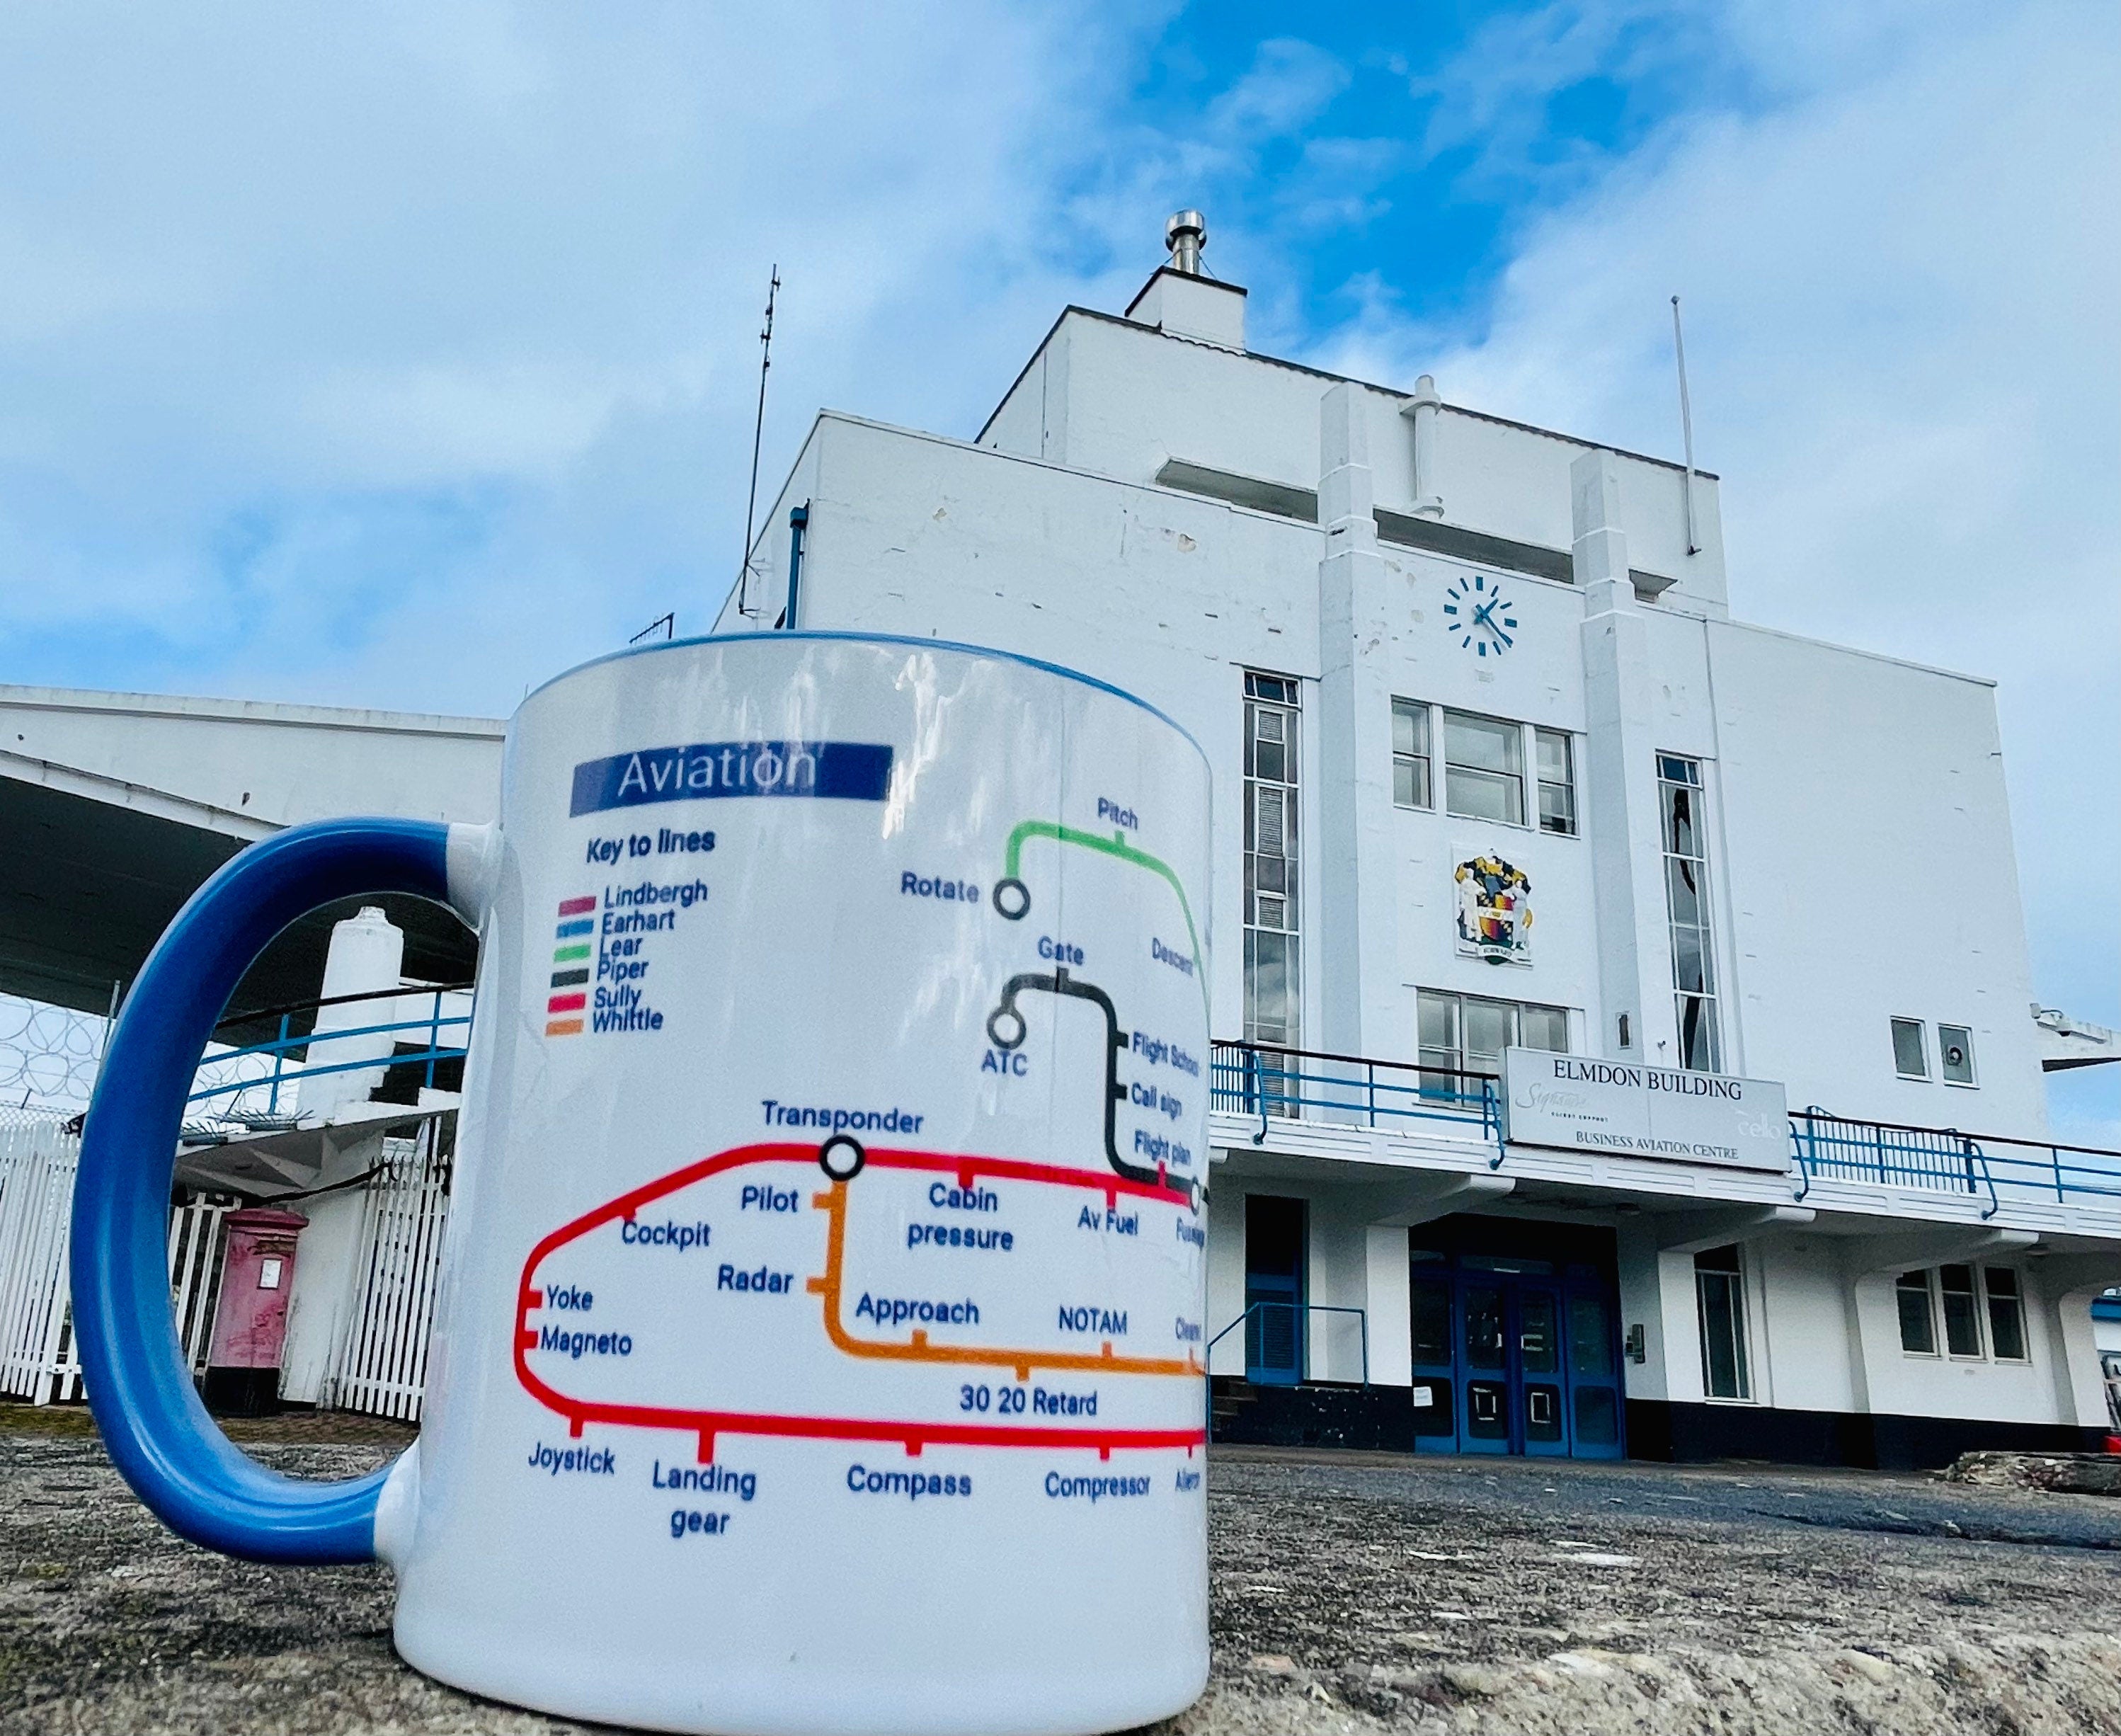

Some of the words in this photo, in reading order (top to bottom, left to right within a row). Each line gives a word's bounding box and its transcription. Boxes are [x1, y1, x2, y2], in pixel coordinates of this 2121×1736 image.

[617, 746, 817, 796] Aviation
[1097, 796, 1138, 830] Pitch
[586, 838, 624, 866] Key
[629, 834, 652, 858] to
[657, 828, 716, 855] lines
[604, 879, 708, 909] Lindbergh
[901, 871, 979, 902] Rotate
[601, 910, 675, 935] Earhart
[599, 937, 644, 959] Lear
[1037, 935, 1085, 966] Gate
[596, 959, 649, 984] Piper
[594, 985, 642, 1010] Sully
[593, 1009, 664, 1034] Whittle
[981, 1049, 1027, 1077] ATC
[1132, 1031, 1169, 1066] Flight
[1553, 1059, 1642, 1088] ELMDON
[1647, 1070, 1742, 1100] BUILDING
[761, 1100, 924, 1134] Transponder
[1131, 1082, 1157, 1108] Call
[1160, 1094, 1182, 1121] sign
[1134, 1129, 1170, 1163] Flight
[1576, 1131, 1633, 1148] BUSINESS
[1635, 1138, 1691, 1154] AVIATION
[1693, 1143, 1739, 1160] CENTRE
[741, 1185, 799, 1214] Pilot
[928, 1182, 998, 1212] Cabin
[1077, 1205, 1101, 1231] Av
[1106, 1209, 1138, 1235] Fuel
[622, 1220, 711, 1252] Cockpit
[907, 1223, 1014, 1252] pressure
[717, 1263, 794, 1294] Radar
[547, 1284, 594, 1312] Yoke
[855, 1291, 980, 1326] Approach
[1058, 1306, 1128, 1335] NOTAM
[540, 1325, 632, 1360] Magneto
[959, 1384, 990, 1412] 30
[998, 1386, 1027, 1415] 20
[1033, 1387, 1097, 1417] Retard
[528, 1441, 615, 1476] Joystick
[652, 1459, 757, 1502] Landing
[847, 1464, 972, 1502] Compass
[1044, 1471, 1150, 1504] Compressor
[670, 1509, 731, 1539] gear
